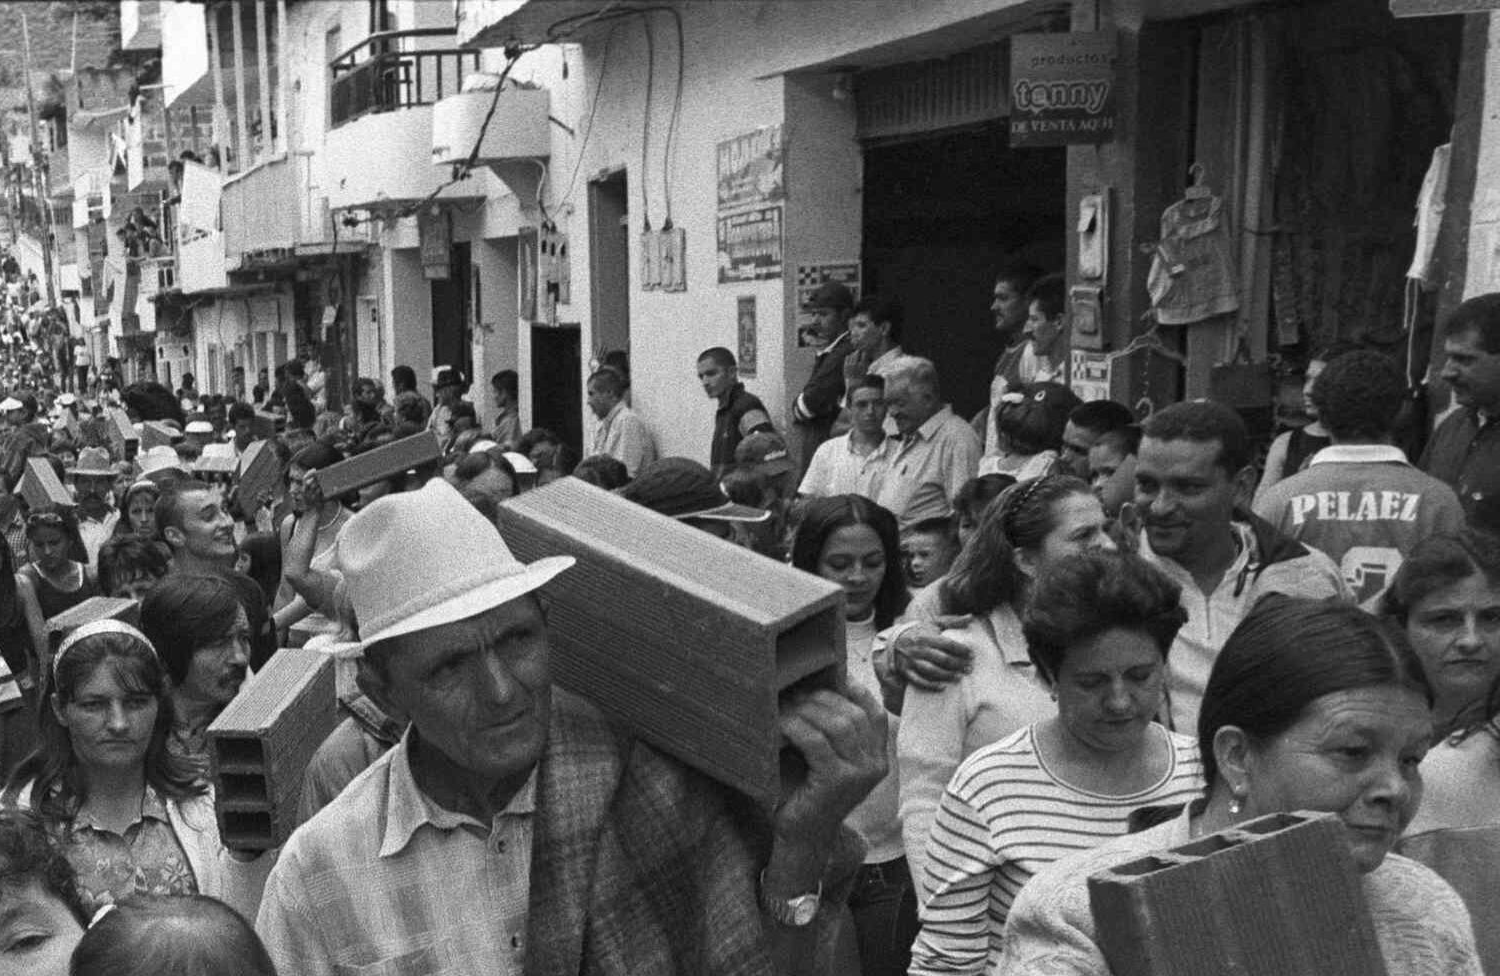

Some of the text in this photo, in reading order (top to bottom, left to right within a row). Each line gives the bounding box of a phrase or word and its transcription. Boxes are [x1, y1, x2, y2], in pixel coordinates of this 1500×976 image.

[1011, 120, 1029, 134] DE
[1031, 118, 1077, 133] VENTA
[1291, 491, 1420, 525] PELAEZ
